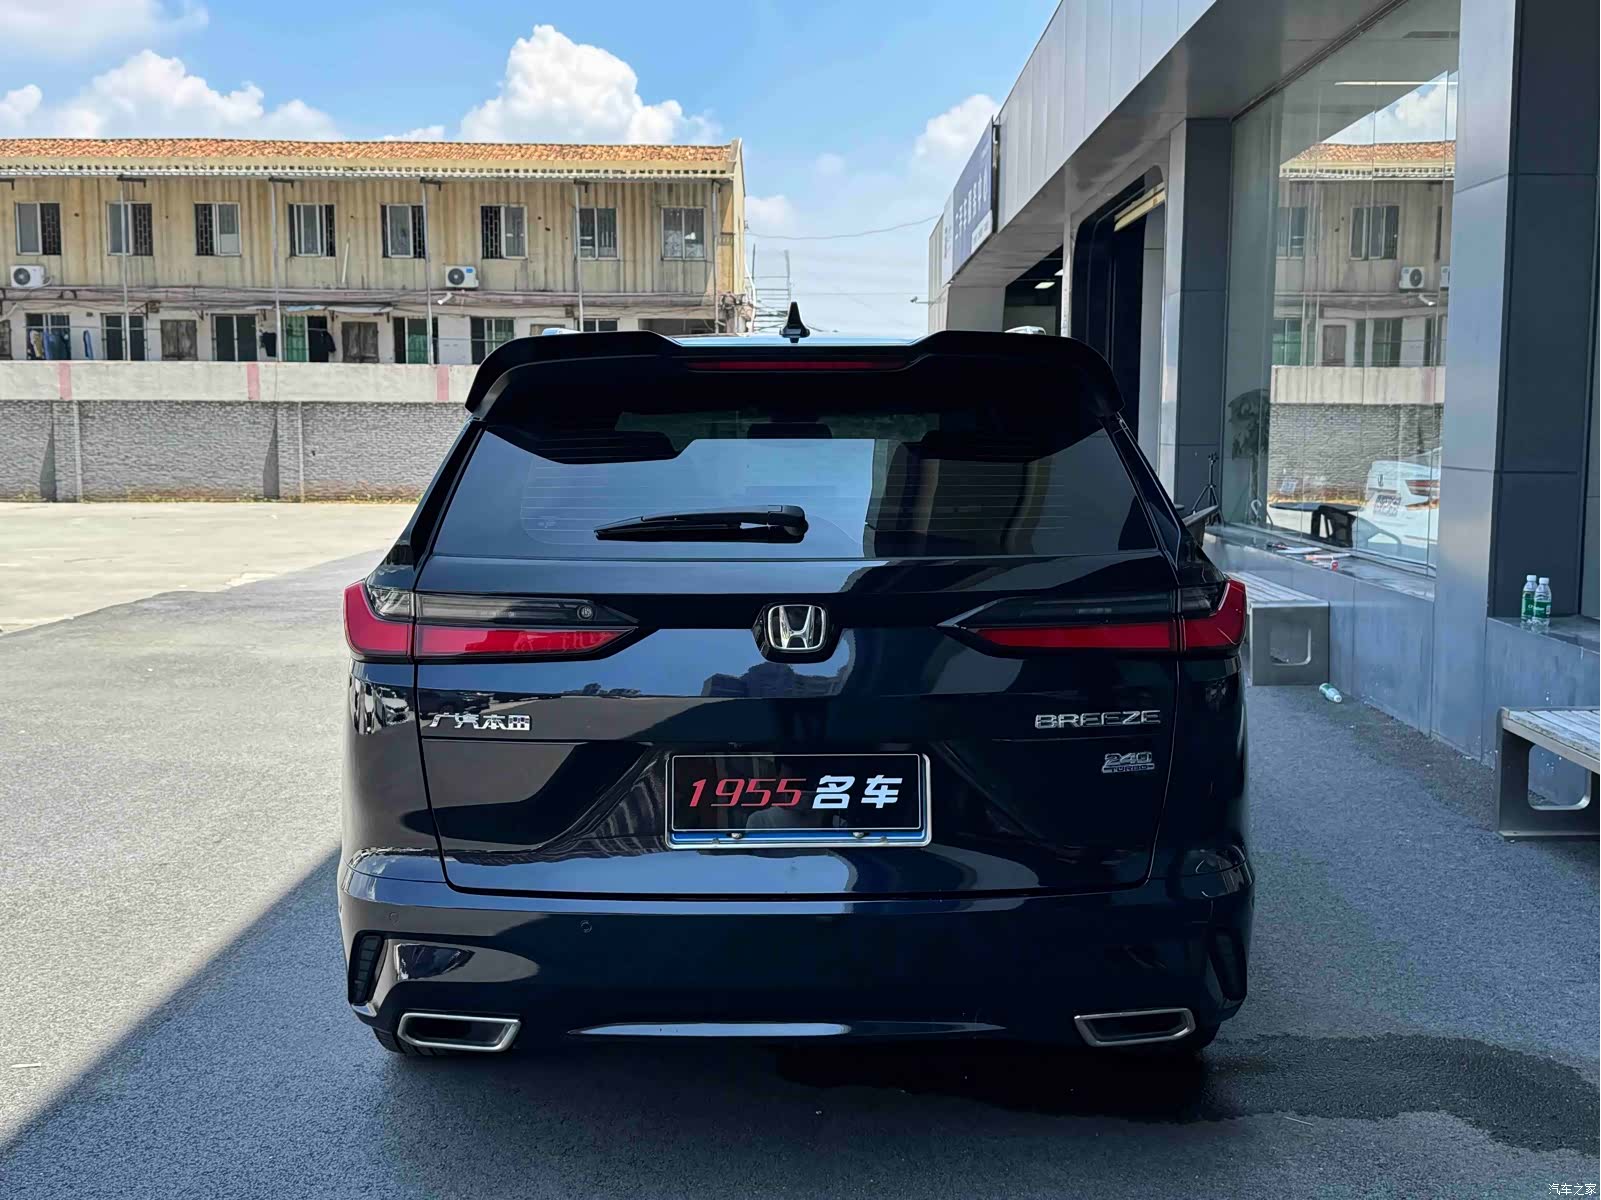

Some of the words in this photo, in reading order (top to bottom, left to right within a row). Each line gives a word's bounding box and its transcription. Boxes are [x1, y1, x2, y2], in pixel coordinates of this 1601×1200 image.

[429, 712, 531, 731] 广汽本田
[1035, 710, 1160, 729] BREEZE
[1104, 751, 1152, 766] 240
